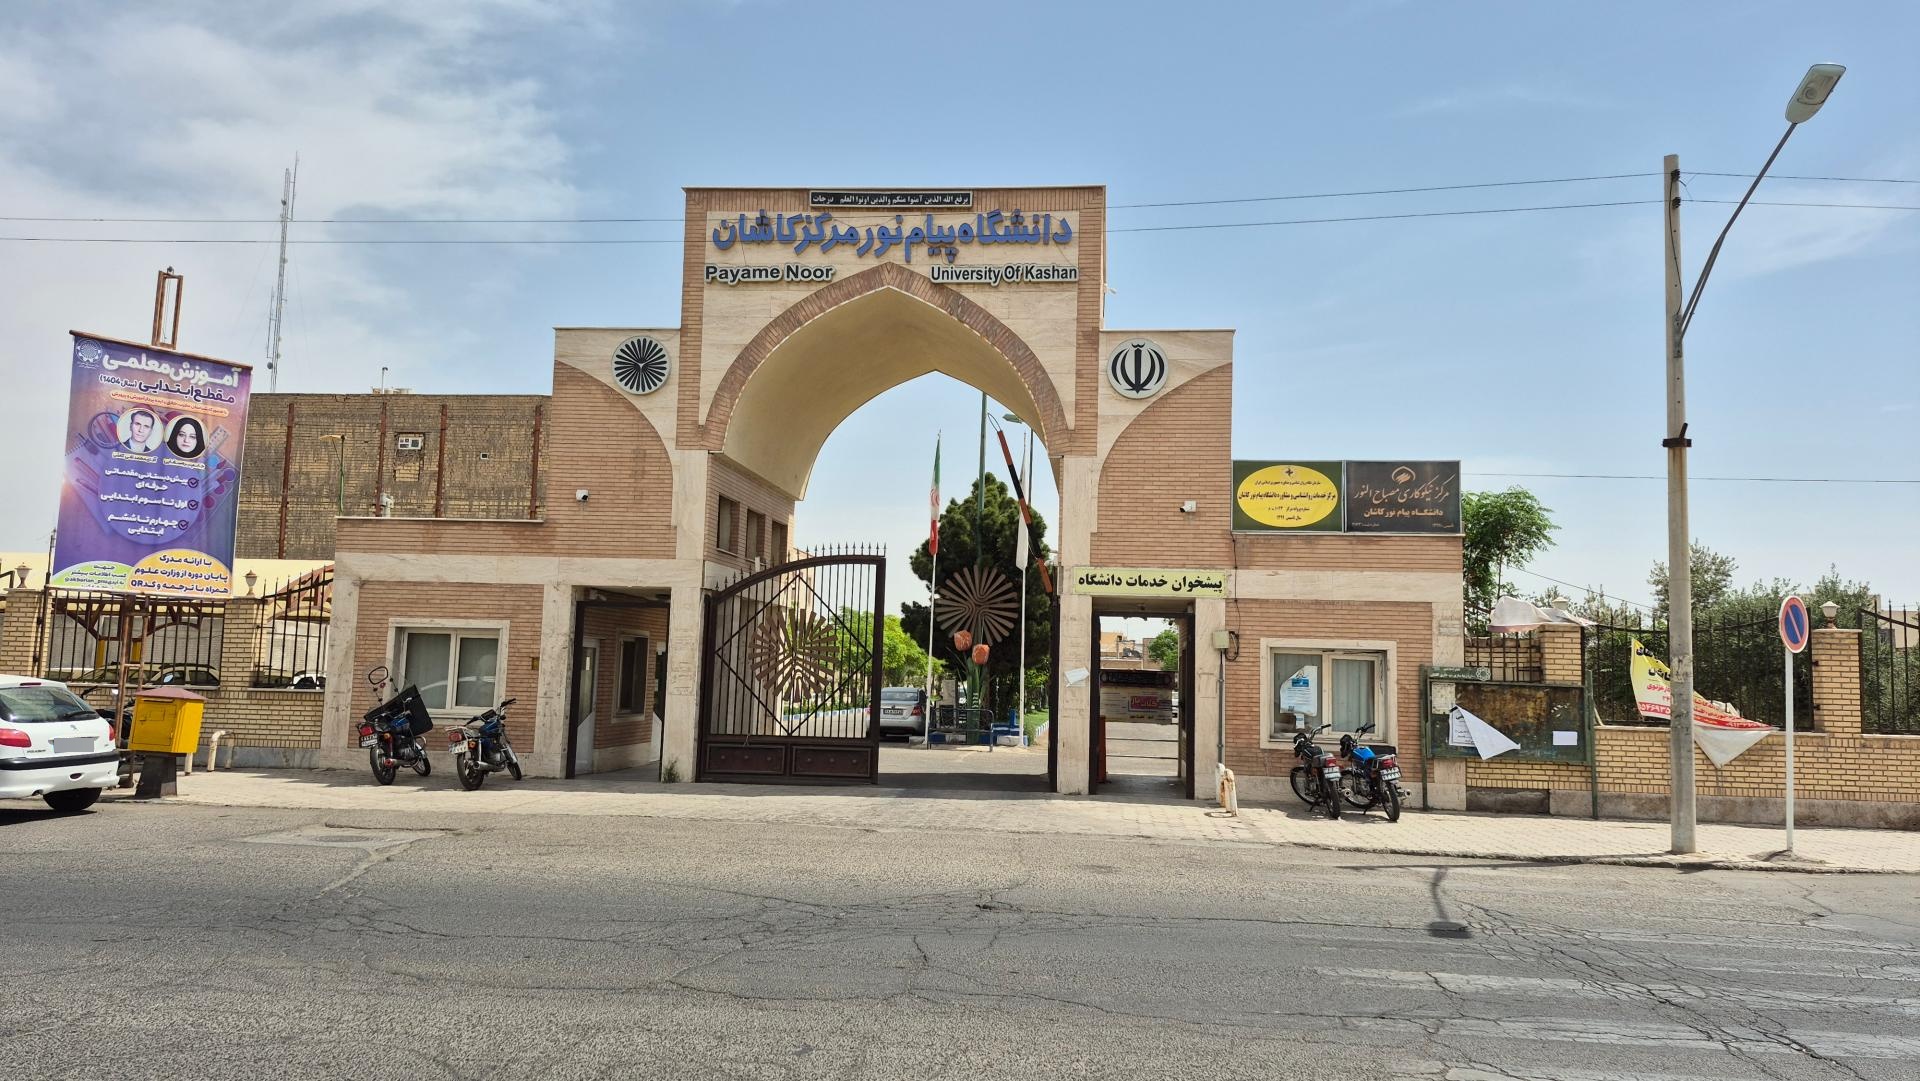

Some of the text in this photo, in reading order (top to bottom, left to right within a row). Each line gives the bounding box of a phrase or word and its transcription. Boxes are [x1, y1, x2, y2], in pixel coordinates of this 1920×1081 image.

[924, 195, 942, 205] الذین
[943, 195, 954, 203] الله
[712, 208, 1072, 263] دانشگاه پیام نور مرکز کاشان
[705, 265, 833, 283] Payame Noor
[931, 265, 1077, 283] University Of Kashan
[102, 352, 242, 388] آموزش معلمی
[138, 379, 194, 397] ابتدایی
[193, 387, 235, 404] مقطع
[1353, 474, 1456, 504] مرکز نیکوکاری مصباح النور
[100, 492, 189, 510] اول تا سوم ابتدایی
[136, 514, 150, 523] تا
[1363, 507, 1444, 518] دانشگاه پیام نور کاشان
[149, 517, 179, 529] چهارم
[127, 525, 165, 537] ابتدایی
[159, 554, 182, 563] مدرک
[203, 558, 212, 566] با
[134, 567, 229, 584] پایان دوره از وزارت علوم
[131, 579, 145, 587] QR
[162, 582, 194, 592] ترجمه
[1078, 573, 1223, 593] پیشخوان خدمات دانشگاه
[205, 586, 229, 594] همراه
